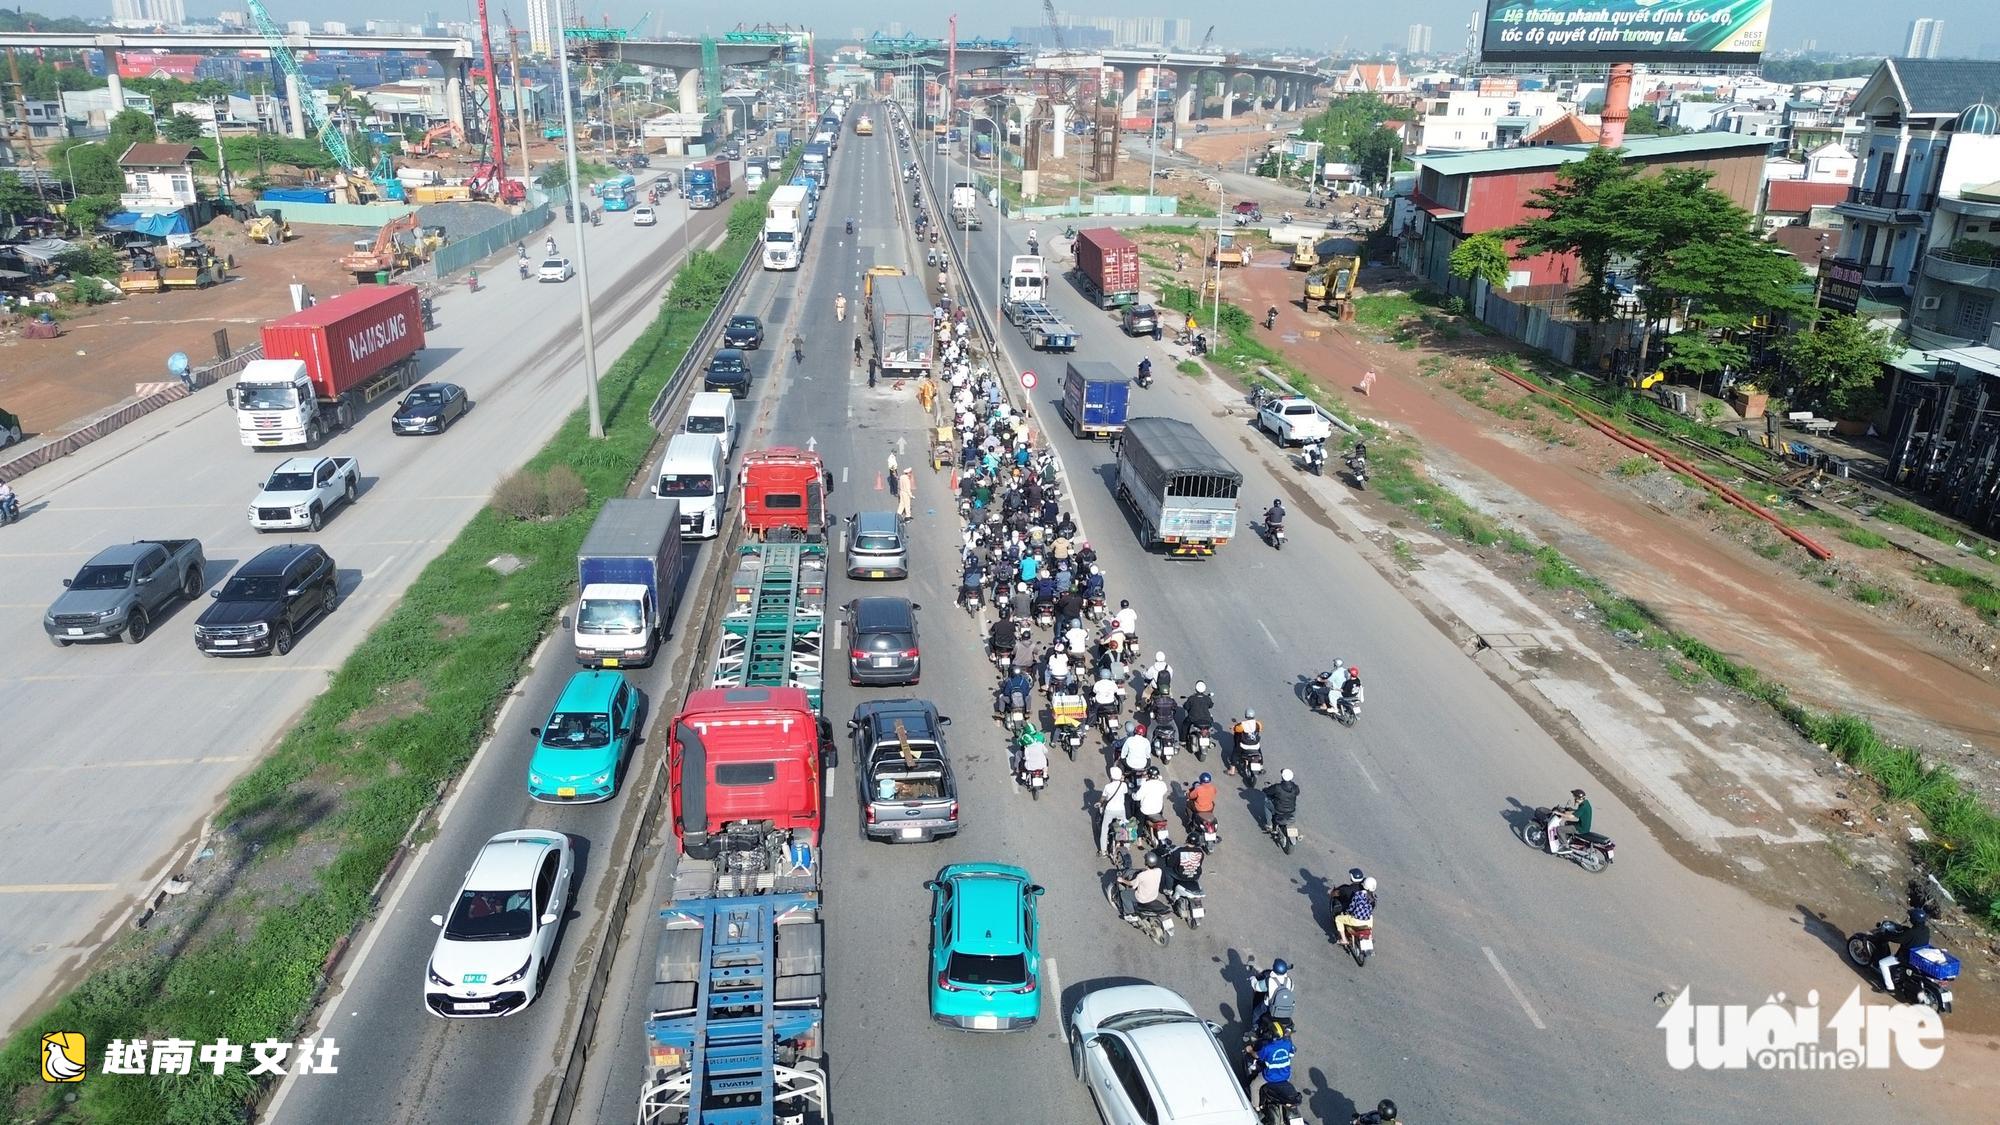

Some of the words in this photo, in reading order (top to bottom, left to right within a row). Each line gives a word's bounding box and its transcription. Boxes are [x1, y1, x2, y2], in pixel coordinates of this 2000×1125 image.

[1503, 8, 1524, 25] Hệ
[1526, 8, 1566, 26] thống
[1565, 8, 1610, 26] phanh
[1611, 8, 1651, 26] quyết
[1652, 8, 1684, 26] định
[1686, 8, 1709, 23] tốc
[1711, 8, 1733, 26] độ,
[1501, 26, 1523, 42] tốc
[1525, 27, 1545, 45] độ
[1547, 26, 1587, 45] quyết
[1588, 27, 1620, 45] định
[1622, 28, 1665, 46] tương
[1665, 27, 1688, 42] lai.
[1733, 39, 1762, 47] CHOICE
[1743, 31, 1763, 39] BEST
[348, 313, 407, 363] NAMSUNG
